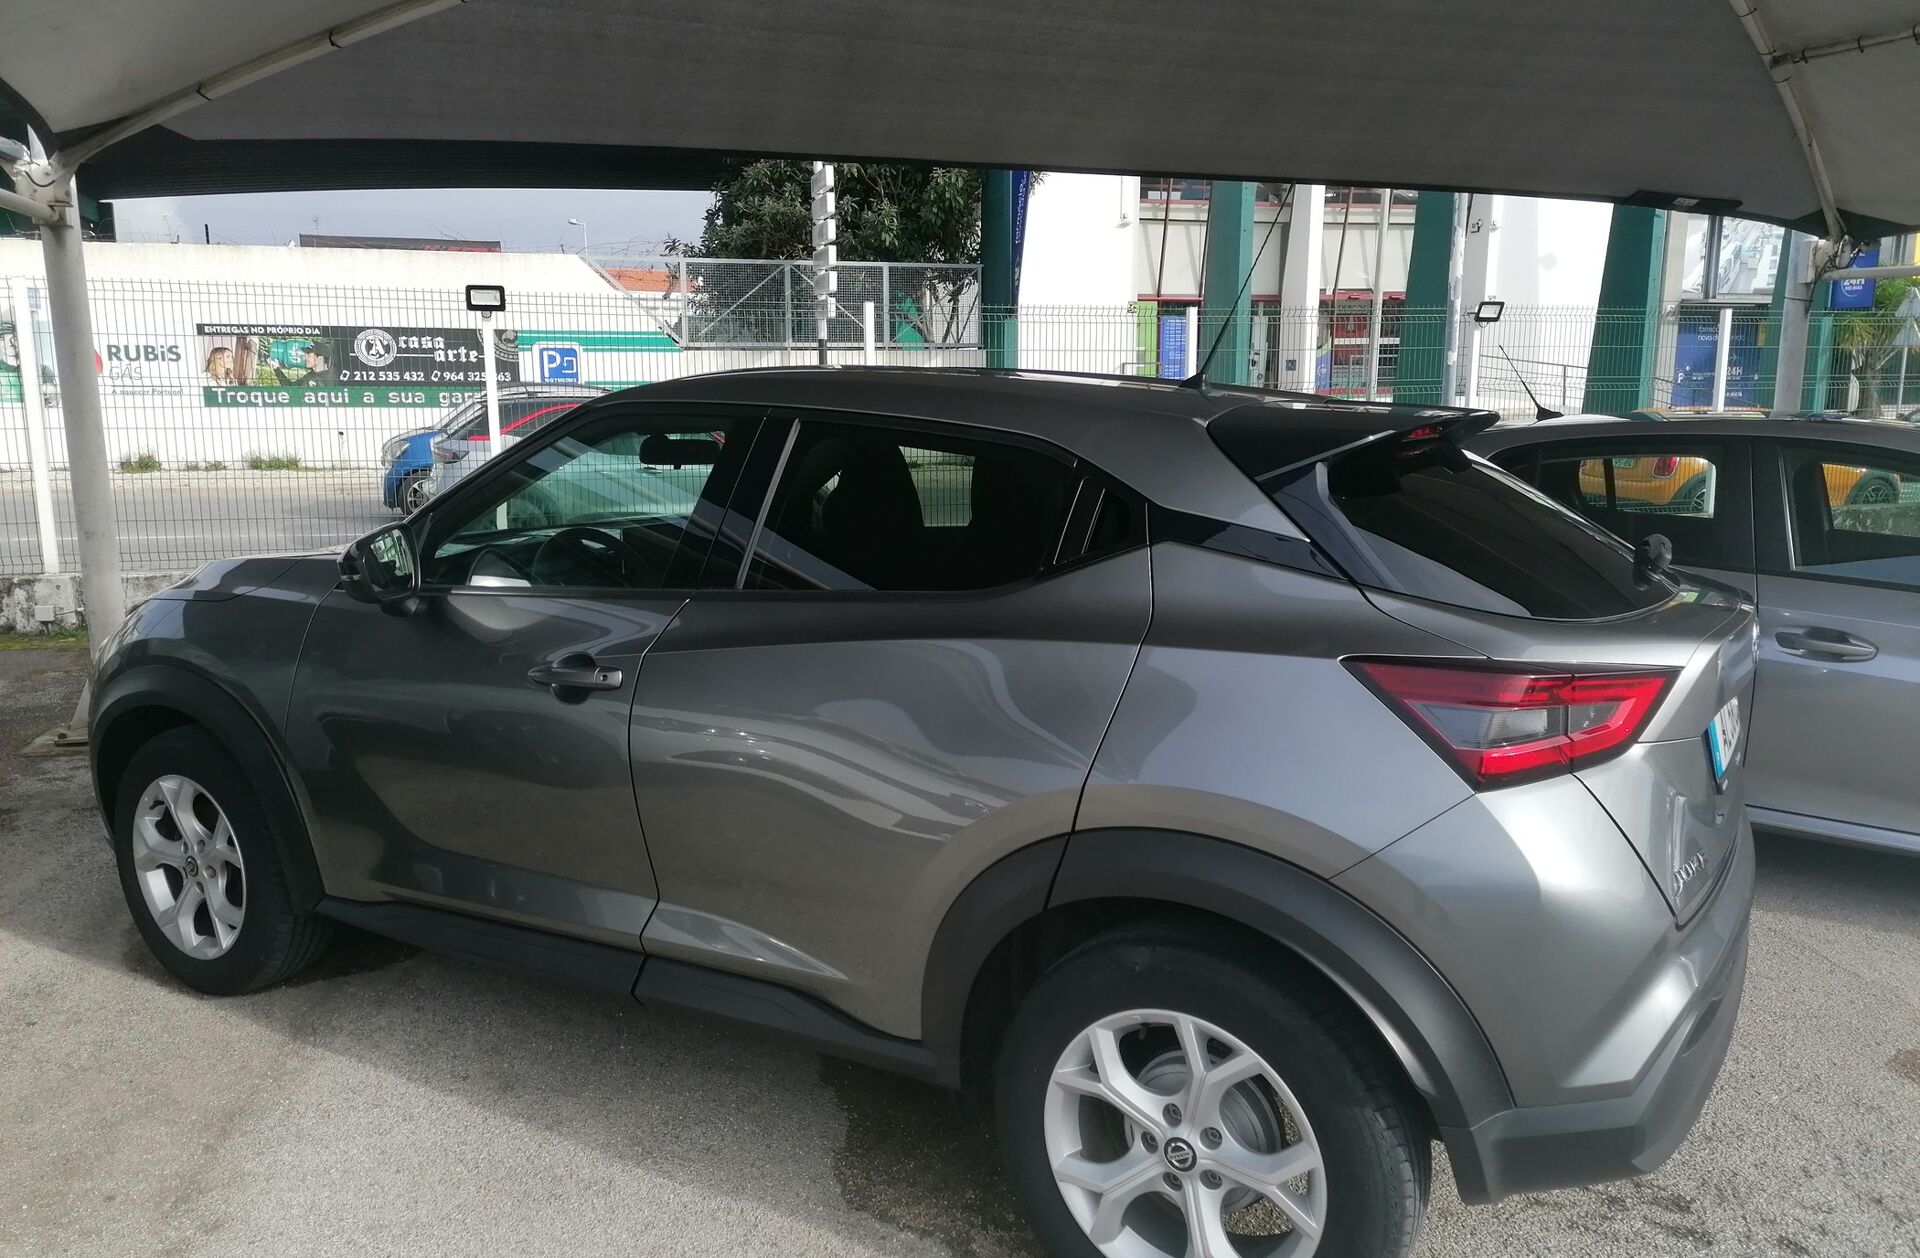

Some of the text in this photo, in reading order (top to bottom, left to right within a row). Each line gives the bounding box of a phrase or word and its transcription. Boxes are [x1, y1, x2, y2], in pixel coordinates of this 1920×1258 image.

[204, 324, 321, 335] ENTREGAS NO PRÓPRIO DIA
[106, 344, 182, 362] RUBiS
[109, 363, 143, 381] GÁS
[353, 371, 425, 381] 212 535 432
[443, 371, 464, 381] 964
[467, 371, 486, 381] 325
[211, 388, 290, 407] Troque
[304, 388, 350, 407] aqui
[363, 391, 375, 404] a
[388, 391, 425, 404] sua
